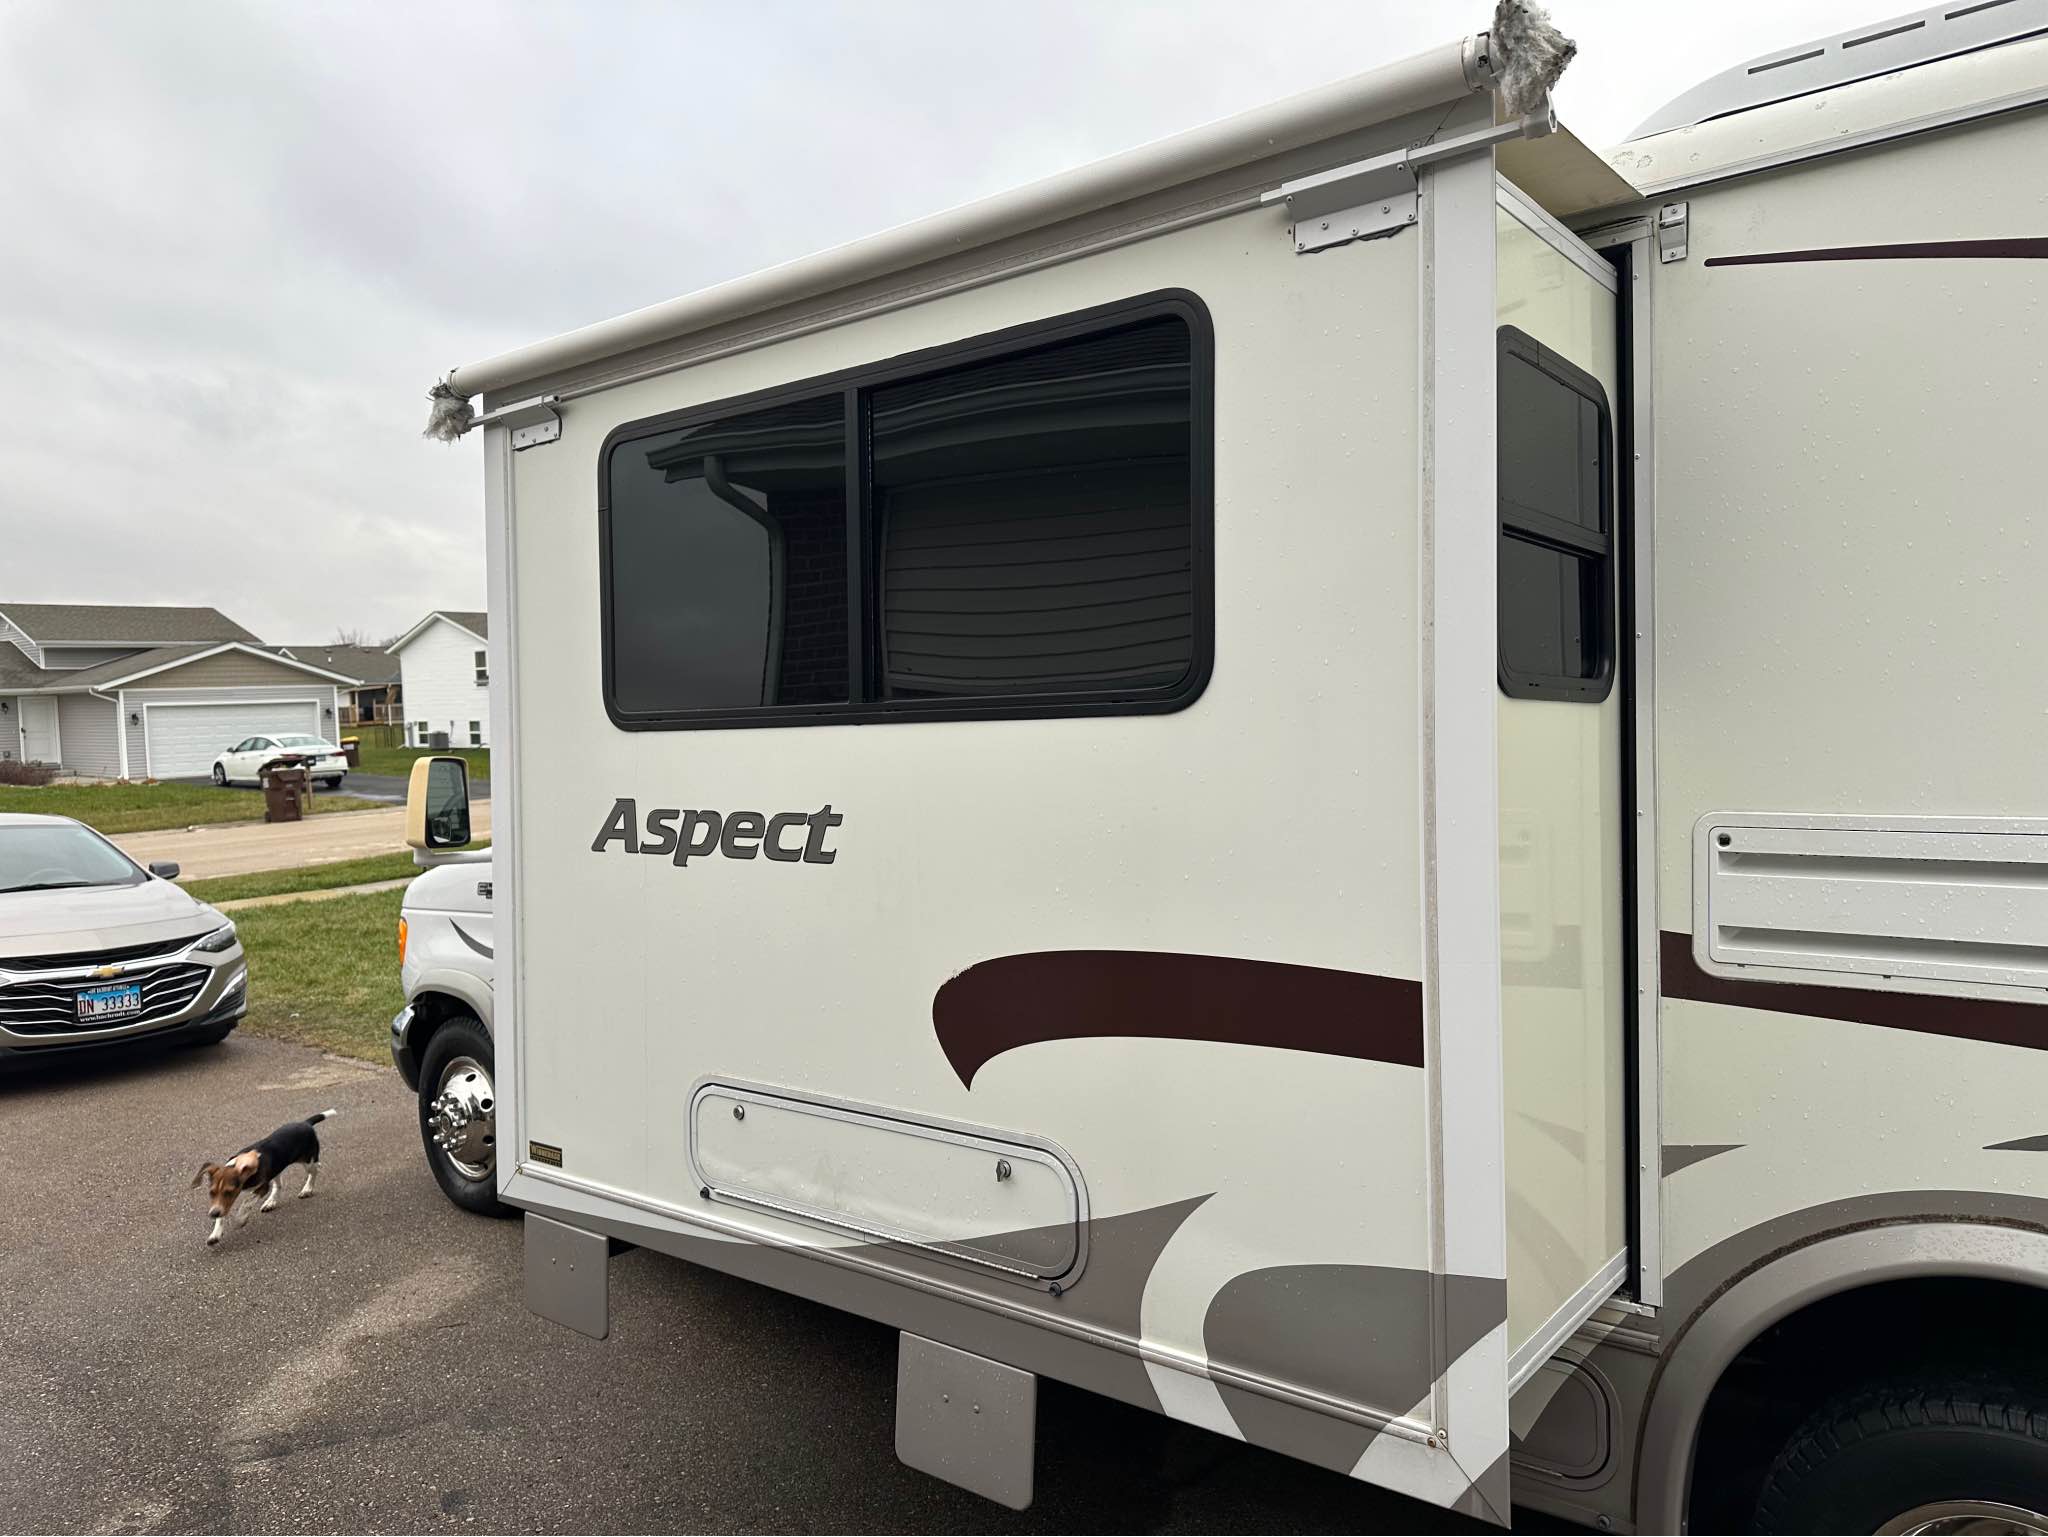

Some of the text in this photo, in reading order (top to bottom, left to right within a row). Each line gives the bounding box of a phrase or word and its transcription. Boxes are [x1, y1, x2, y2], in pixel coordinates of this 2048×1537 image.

[591, 798, 843, 867] Aspect
[79, 993, 139, 1015] DN 33333
